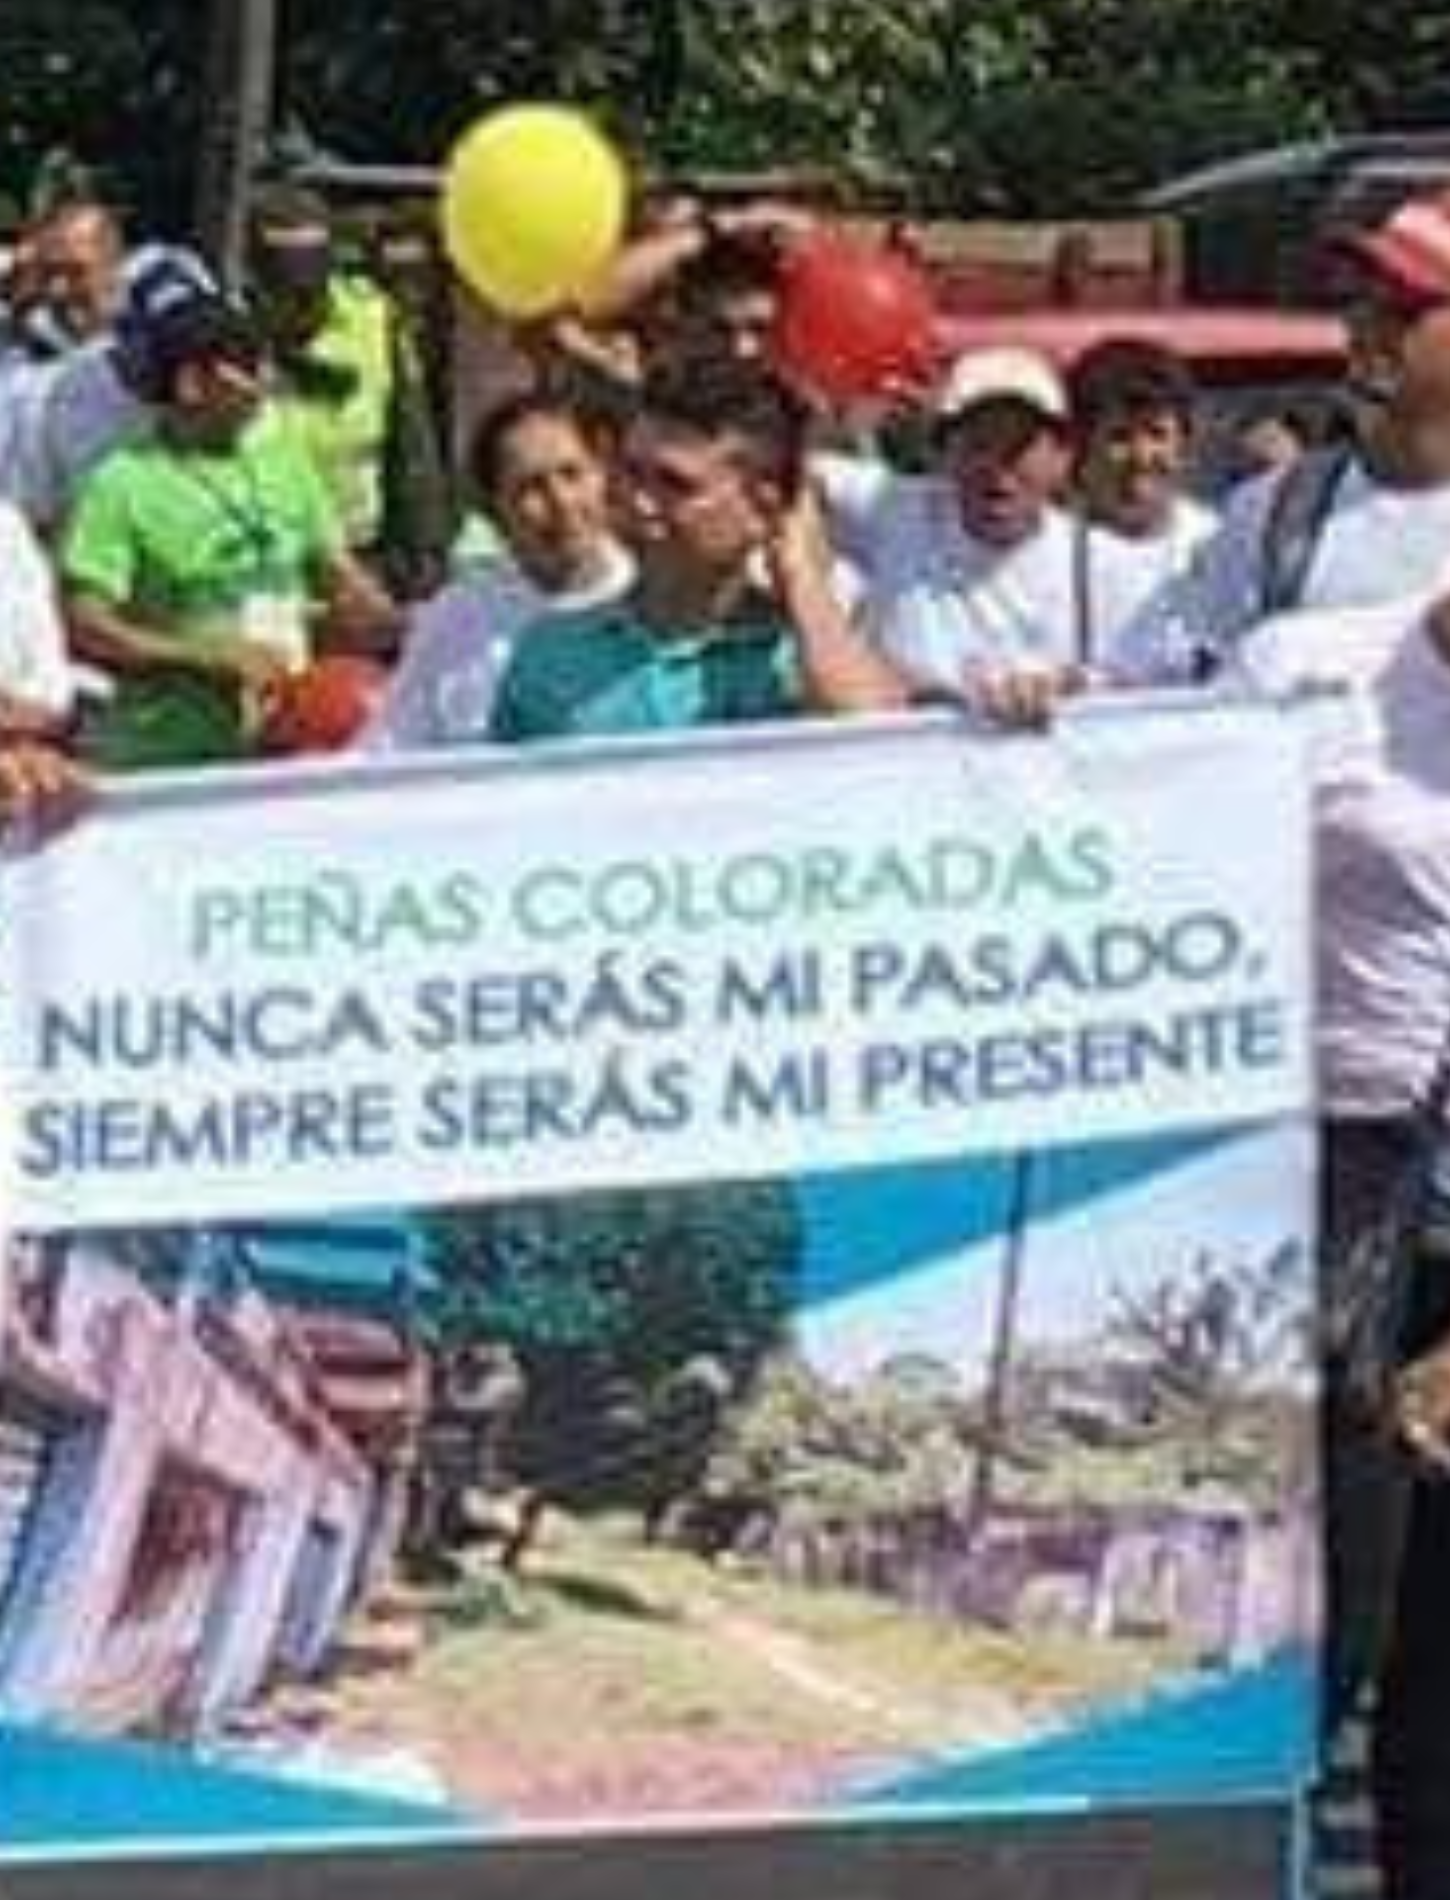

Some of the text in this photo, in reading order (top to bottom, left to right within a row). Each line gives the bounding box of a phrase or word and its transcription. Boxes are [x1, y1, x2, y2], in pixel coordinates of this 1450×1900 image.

[192, 828, 1114, 958] PEÑAS COLORADAS
[37, 911, 1266, 1070] NUNCA SERÁS MI PASADO,
[17, 998, 1283, 1177] SIEMPRE SERÁS MI PRESENTE
